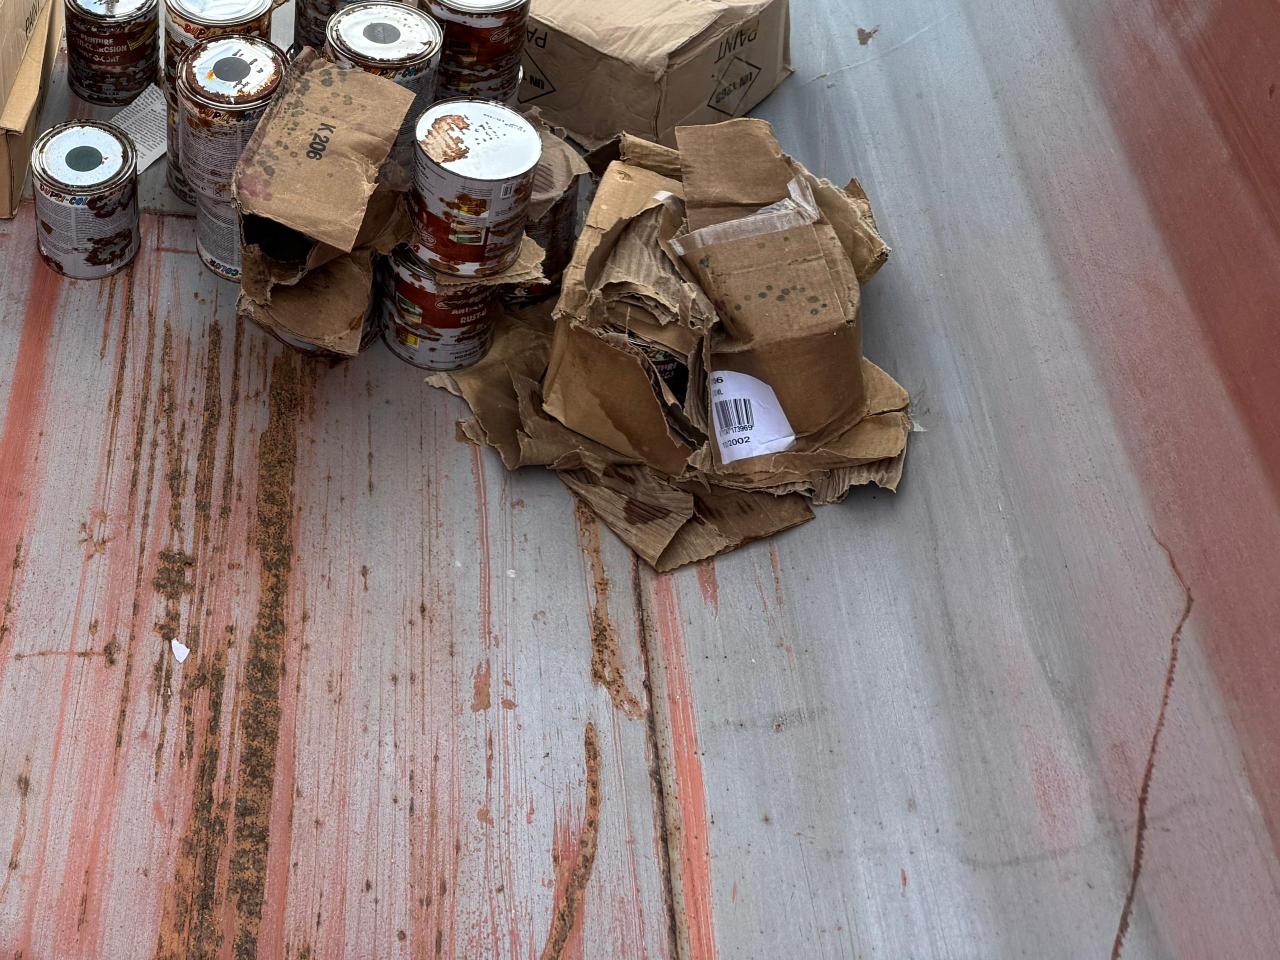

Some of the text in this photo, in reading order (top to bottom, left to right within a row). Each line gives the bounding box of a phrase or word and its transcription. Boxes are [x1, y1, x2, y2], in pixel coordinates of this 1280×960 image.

[714, 13, 760, 65] PAINT
[306, 122, 336, 160] K 206
